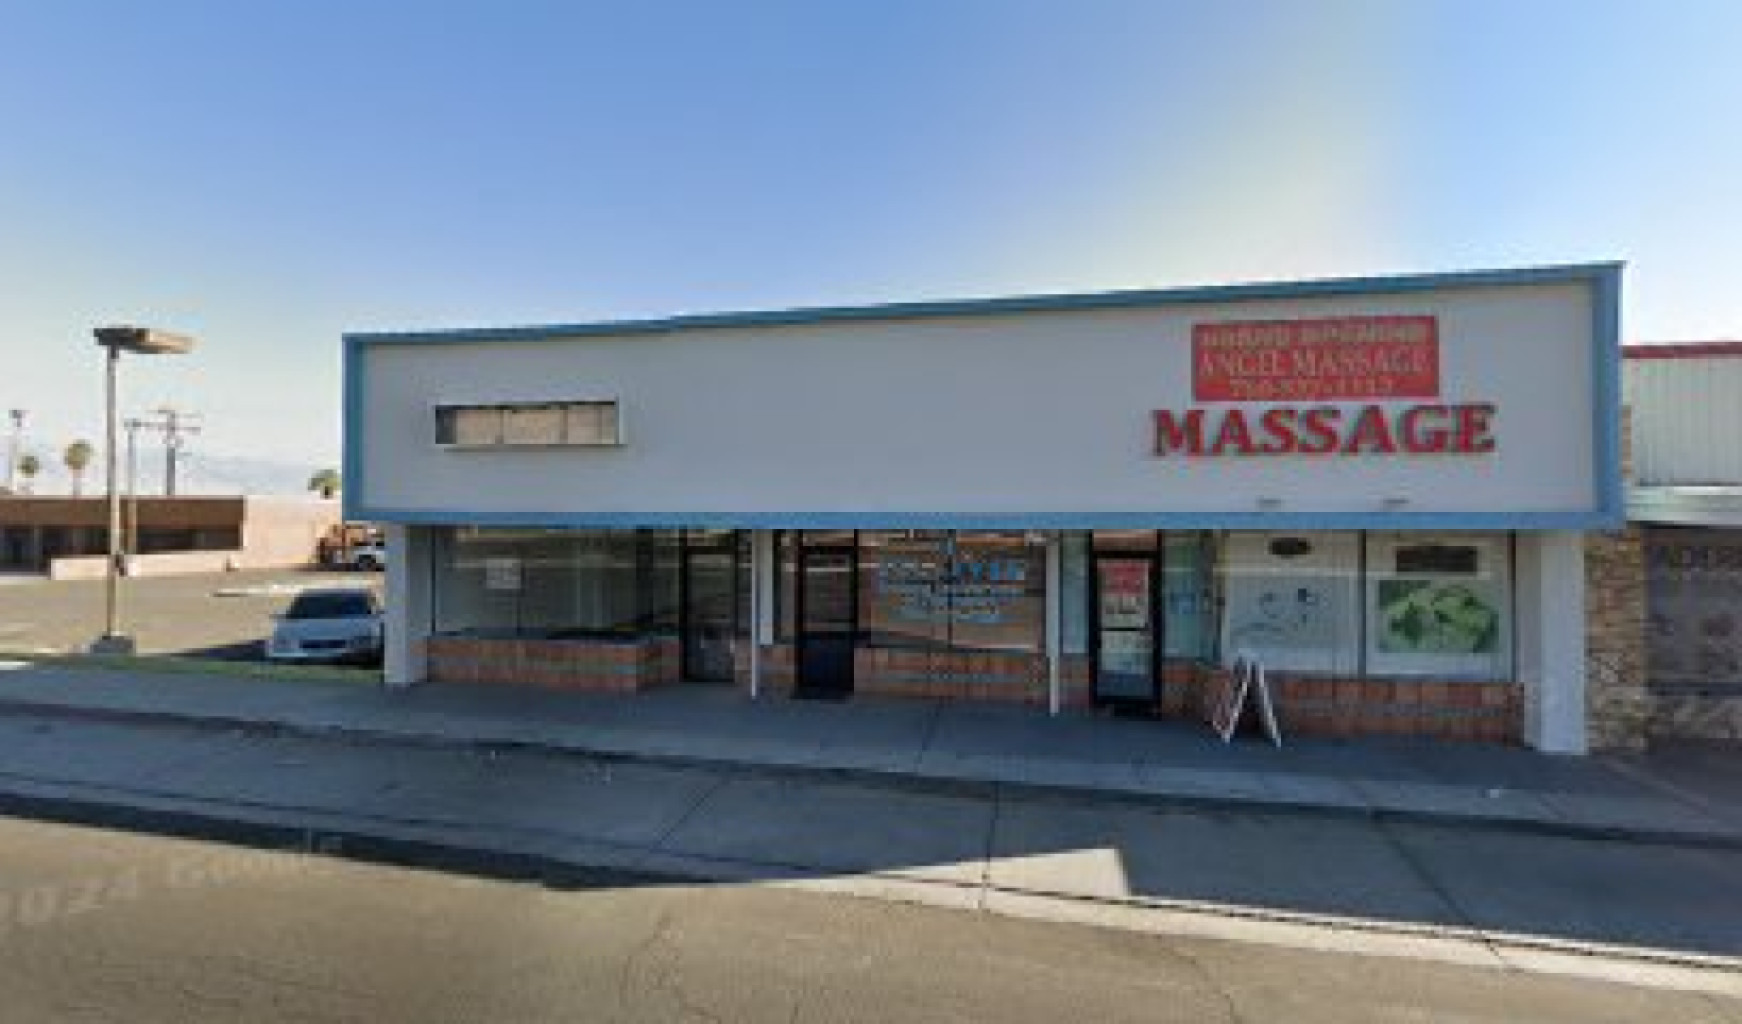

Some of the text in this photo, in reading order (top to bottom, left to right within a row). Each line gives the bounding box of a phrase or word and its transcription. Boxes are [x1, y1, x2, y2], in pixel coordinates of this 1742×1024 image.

[1201, 347, 1427, 378] ANGEL MASSAGE
[1152, 404, 1497, 457] MASSAGE
